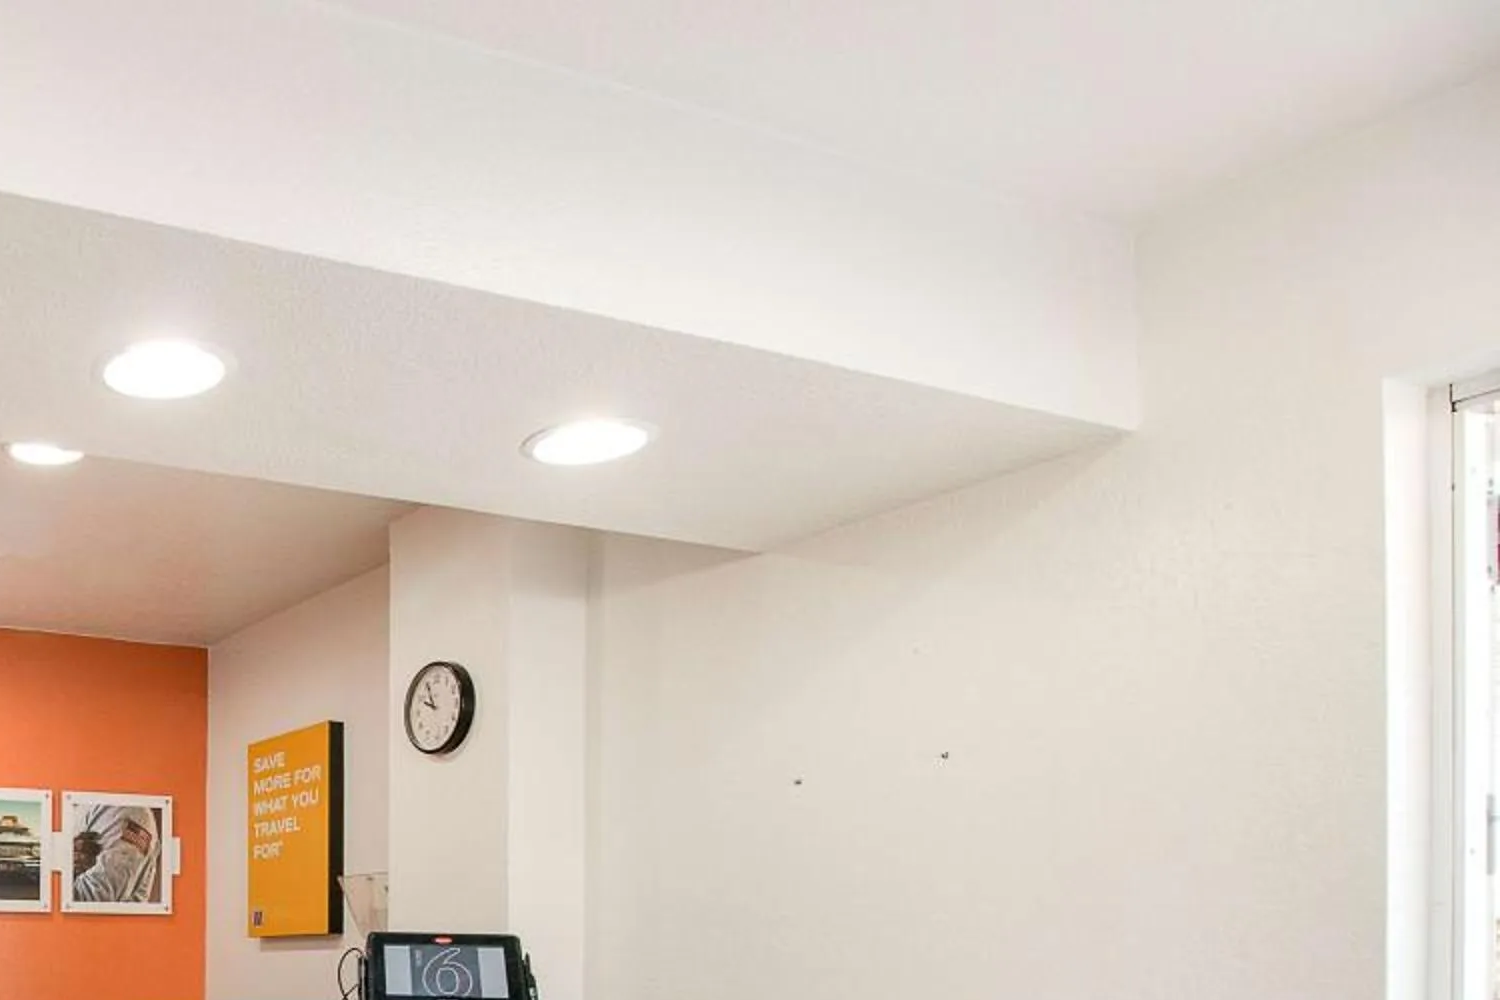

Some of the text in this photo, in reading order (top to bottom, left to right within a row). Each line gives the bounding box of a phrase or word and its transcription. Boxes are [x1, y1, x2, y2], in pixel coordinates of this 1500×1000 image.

[253, 751, 286, 774] SAVE
[253, 764, 323, 796] MORE FOR
[253, 785, 320, 818] WHAT YOU
[253, 815, 301, 839] TRAVEL
